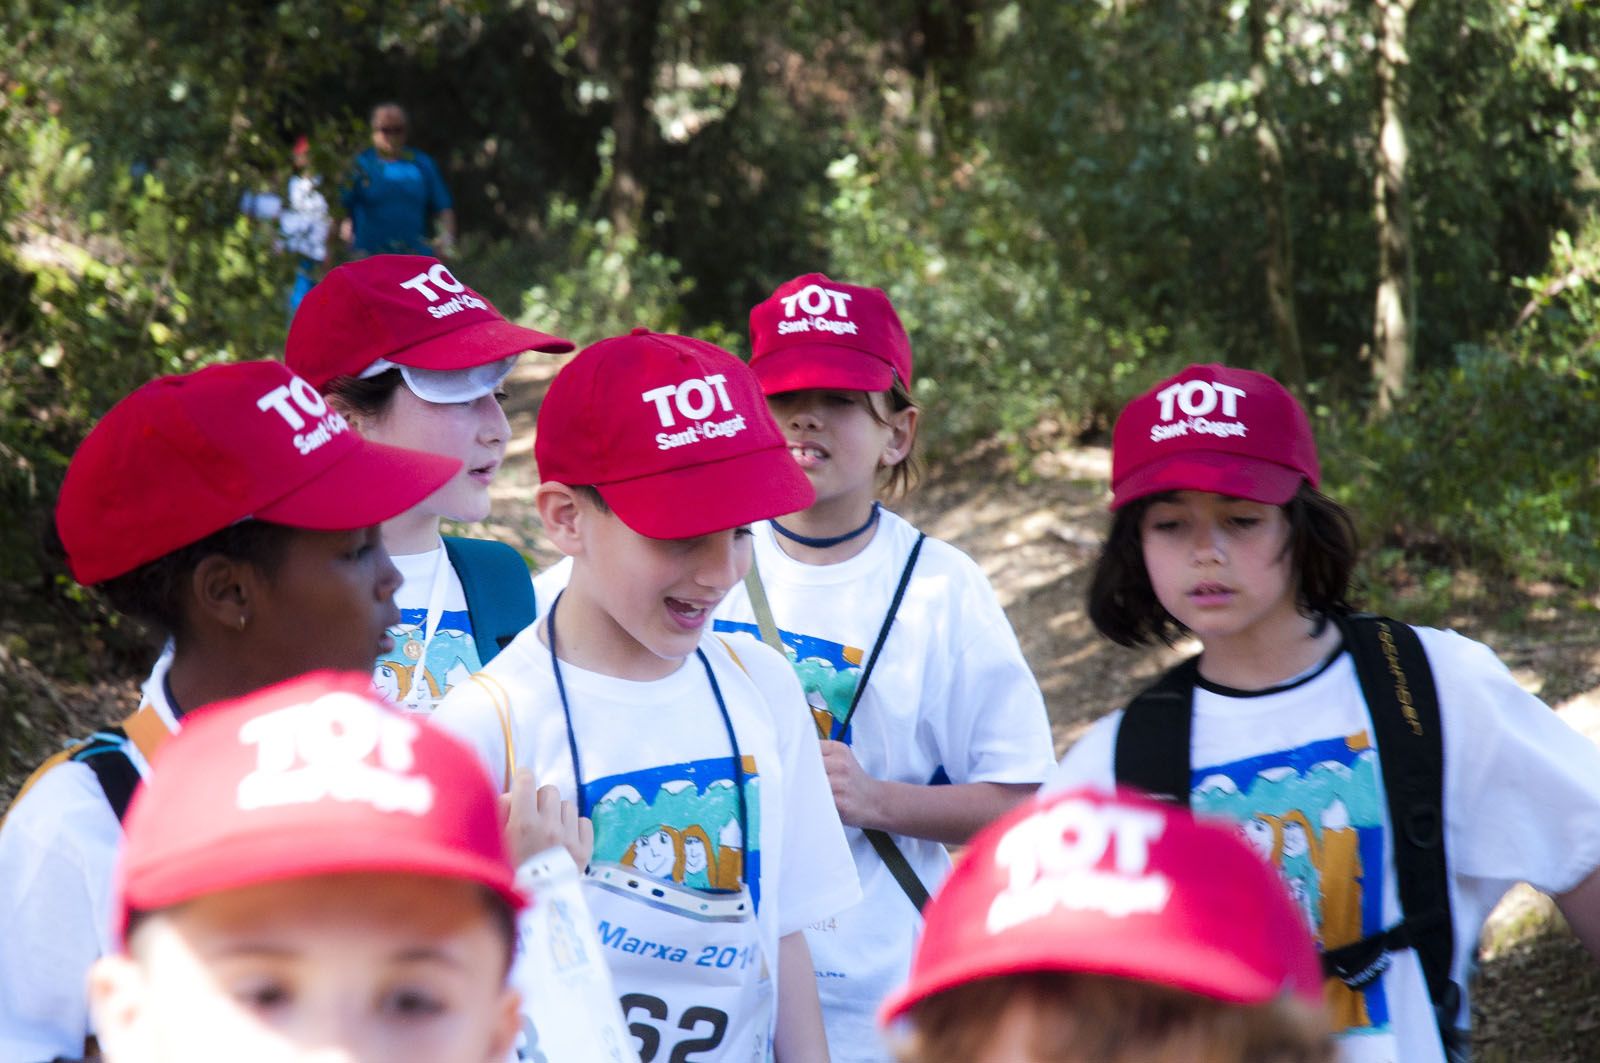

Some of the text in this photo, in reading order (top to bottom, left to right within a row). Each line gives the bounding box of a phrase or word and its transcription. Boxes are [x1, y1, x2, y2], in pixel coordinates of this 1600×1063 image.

[400, 263, 465, 302] TO
[780, 284, 852, 318] TOT
[427, 297, 465, 318] Sant
[777, 317, 810, 335] Sant
[256, 375, 327, 431] TO
[641, 373, 734, 428] TOT
[1156, 379, 1246, 422] TOT
[293, 422, 332, 455] Sant
[655, 413, 747, 450] Sant Cugat
[1149, 419, 1188, 443] Sant
[238, 691, 420, 772] TOT
[994, 799, 1167, 893] TOT
[597, 920, 688, 963] Marxa
